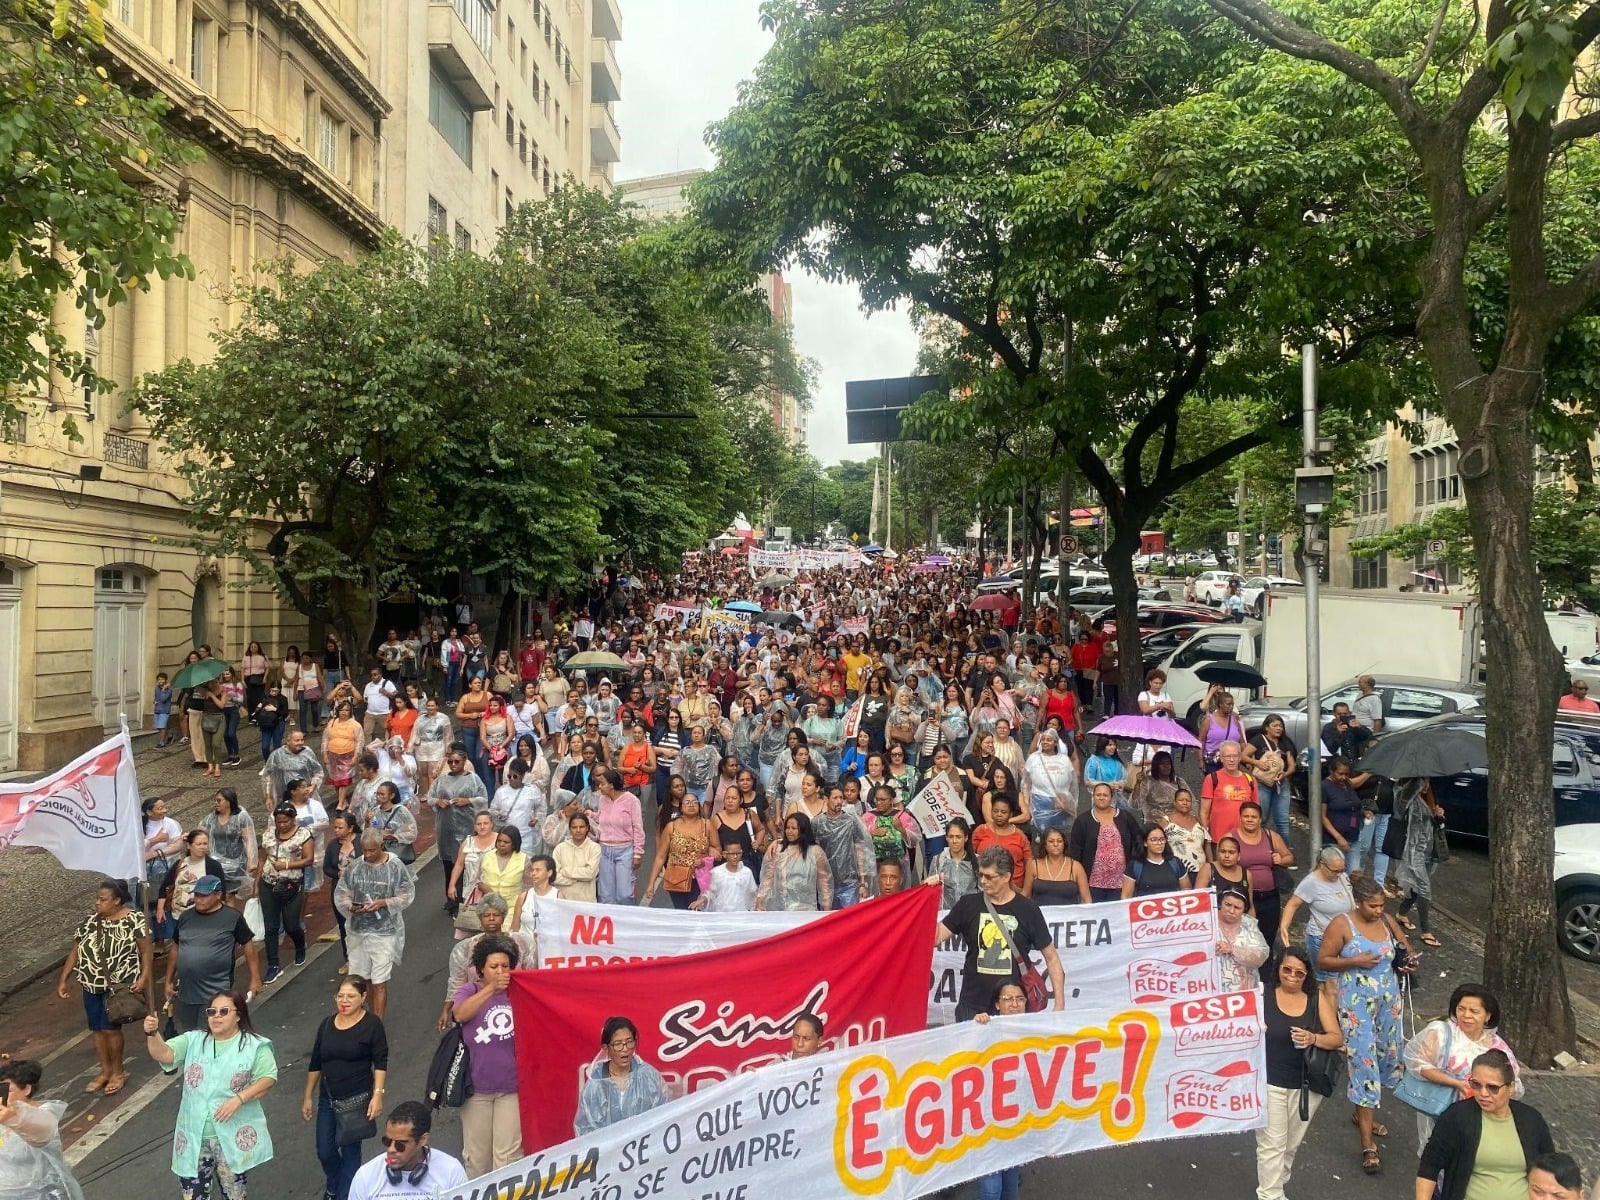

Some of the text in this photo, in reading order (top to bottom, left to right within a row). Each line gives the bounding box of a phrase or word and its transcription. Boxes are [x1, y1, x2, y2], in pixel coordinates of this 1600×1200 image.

[922, 788, 949, 831] EDE-BH
[1136, 895, 1200, 920] CSP
[570, 914, 615, 946] NA
[1049, 918, 1112, 949] TETA
[1134, 917, 1209, 940] Conlutas
[1134, 977, 1208, 994] REDE-BH
[1136, 963, 1188, 979] Sind
[660, 983, 828, 1060] Sind
[1181, 994, 1246, 1024] CSP
[1178, 1021, 1255, 1047] Conlutas
[851, 1022, 1149, 1169] É GREVE!
[1175, 1074, 1231, 1093] Sind
[1172, 1091, 1253, 1112] REDE-BH
[618, 1133, 651, 1172] SE
[662, 1122, 682, 1155] O
[695, 1100, 743, 1142] QUE
[757, 1066, 824, 1120] VOCÊ
[633, 1166, 668, 1199] SE
[681, 1128, 802, 1185] CUMPRE,
